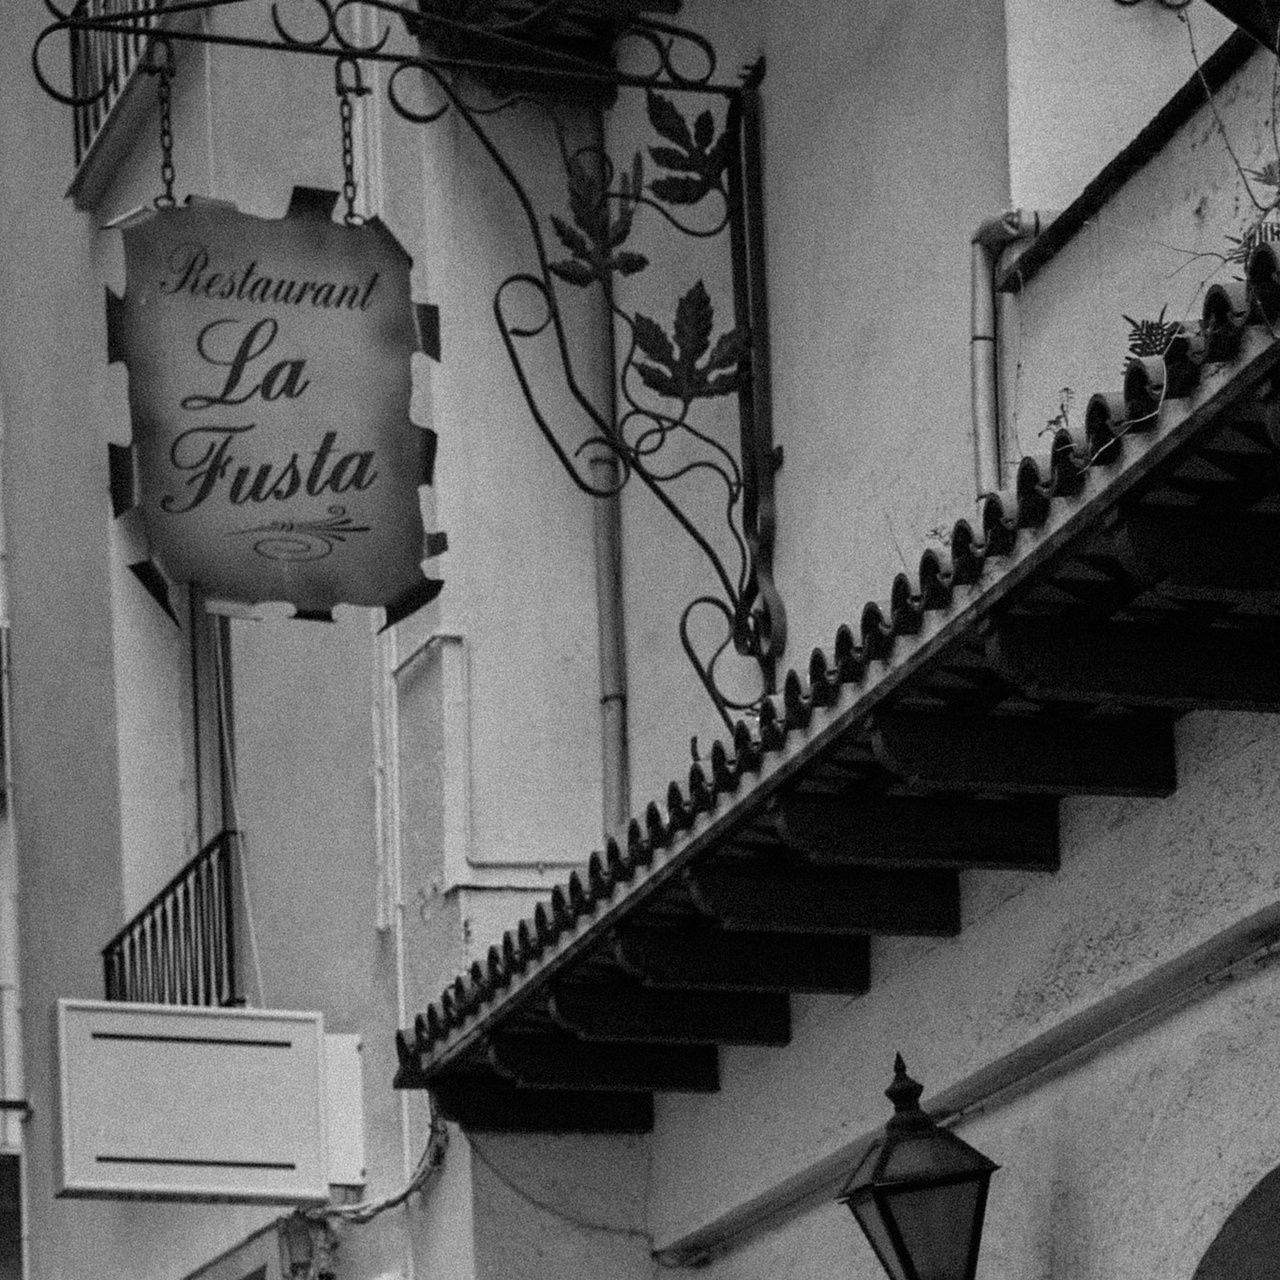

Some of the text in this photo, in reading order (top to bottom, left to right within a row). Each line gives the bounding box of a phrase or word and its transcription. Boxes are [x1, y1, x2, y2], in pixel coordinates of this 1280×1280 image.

[161, 243, 379, 312] Restaurant
[181, 317, 311, 410] La
[160, 424, 378, 514] Fusta
